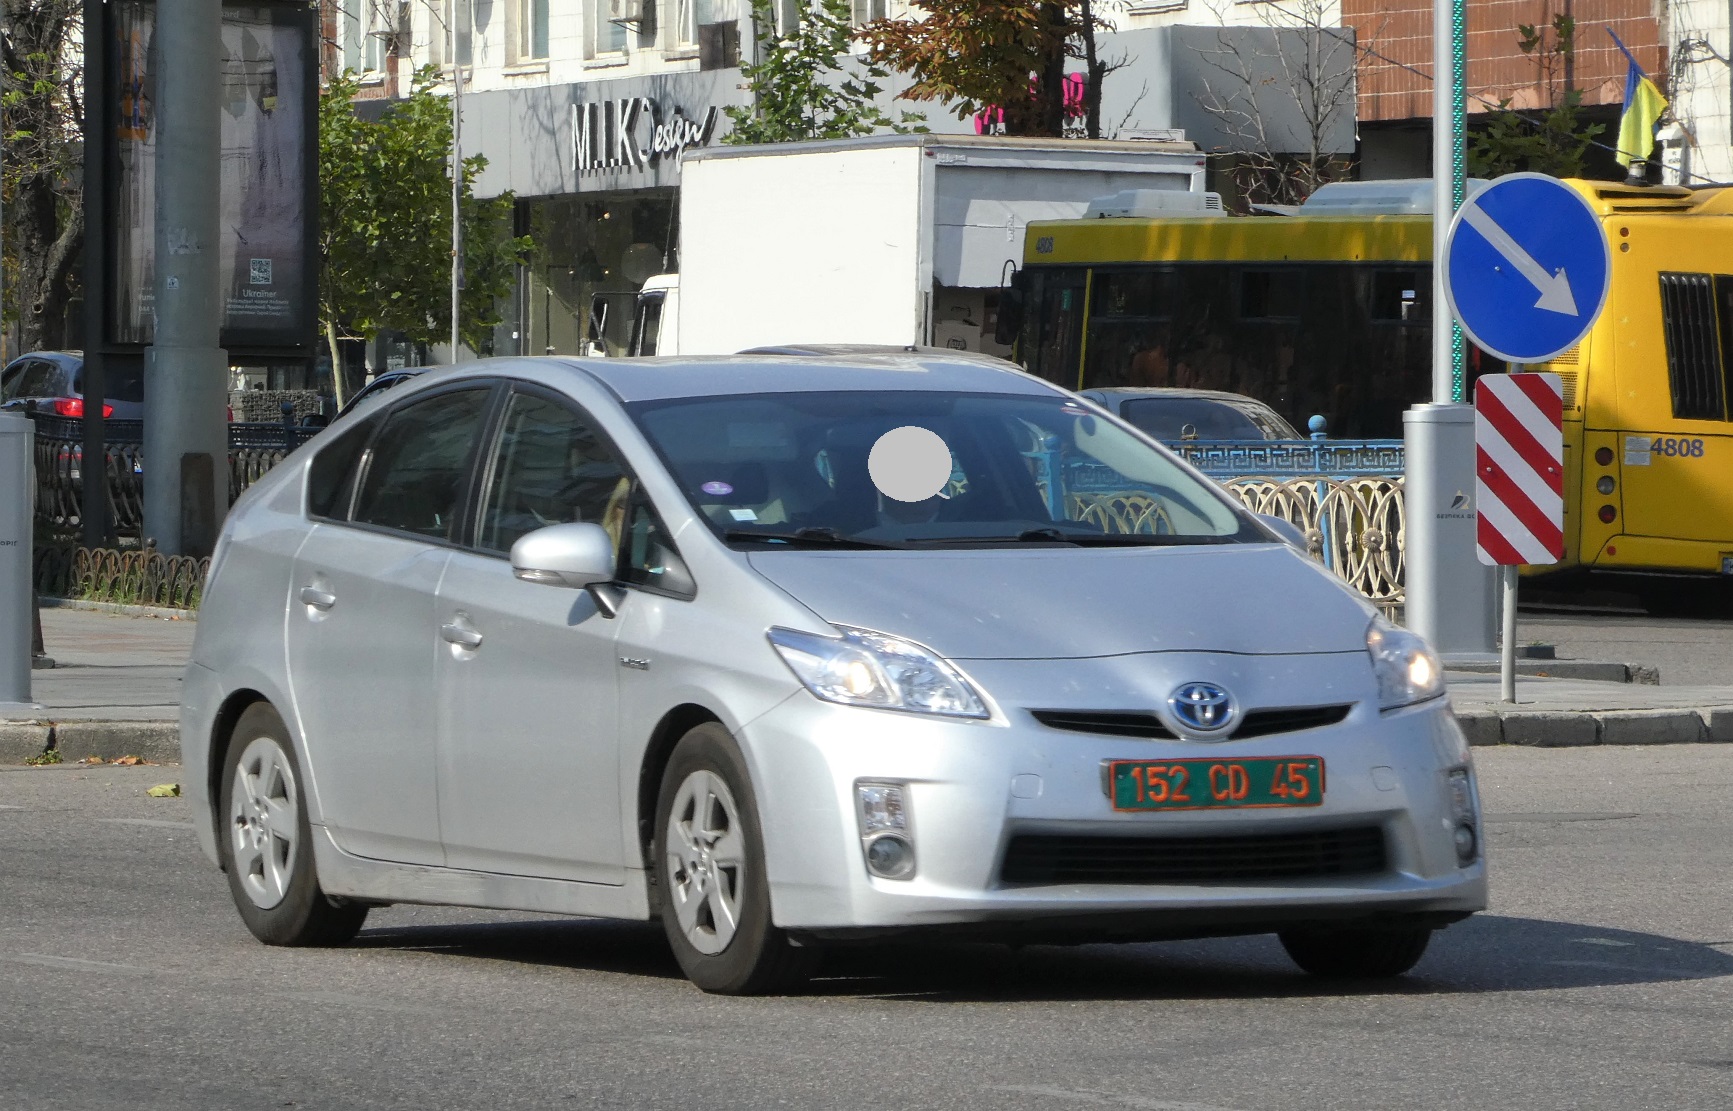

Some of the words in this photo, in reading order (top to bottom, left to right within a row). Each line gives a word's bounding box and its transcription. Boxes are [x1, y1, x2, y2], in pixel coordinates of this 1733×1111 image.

[638, 97, 716, 174] Design
[1651, 438, 1704, 458] 4808
[1130, 765, 1191, 803] 152
[1208, 764, 1251, 801] CD
[1269, 762, 1311, 800] 45
